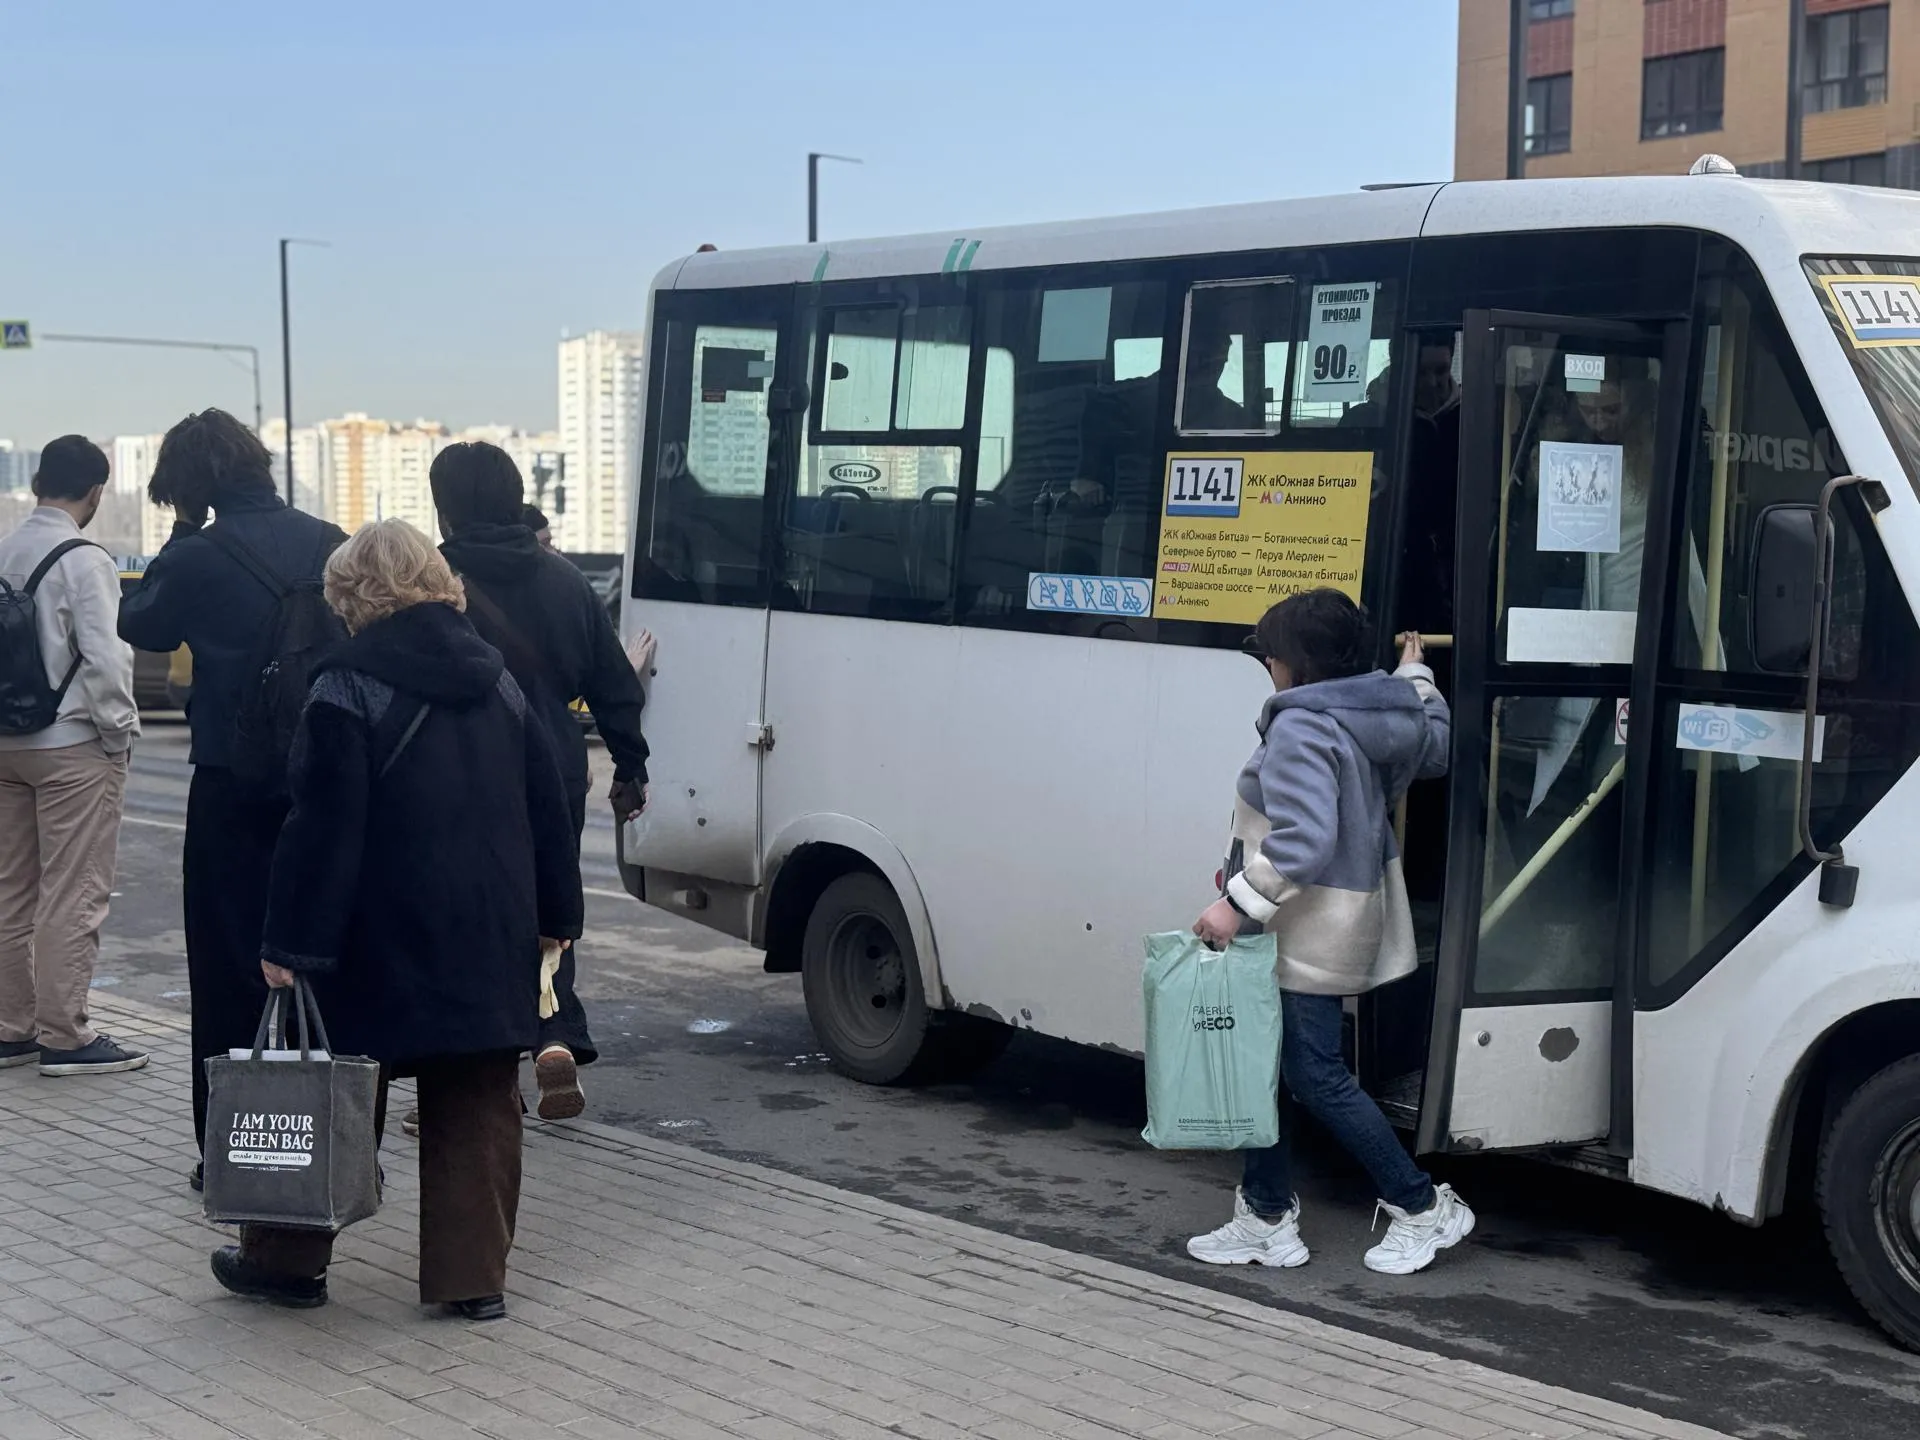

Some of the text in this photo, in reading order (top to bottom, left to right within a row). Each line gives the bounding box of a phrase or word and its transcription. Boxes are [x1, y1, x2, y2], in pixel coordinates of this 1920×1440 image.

[1317, 288, 1370, 304] СТОИМОСТЬ
[1321, 307, 1361, 322] ПРОЕЗДА
[1841, 290, 1920, 324] 1141
[1173, 466, 1236, 502] 1141
[1247, 474, 1357, 490] ЖК «Южная Битца»
[1284, 494, 1326, 506] Аннино
[1164, 529, 1179, 540] ЖК
[1264, 532, 1329, 545] Ботанический
[1331, 536, 1348, 547] сад
[1162, 545, 1204, 558] Северное
[1206, 546, 1237, 560] Бутово
[1285, 550, 1324, 563] Мерлен
[1190, 563, 1215, 575] МЦД
[1257, 565, 1313, 579] (Автовокзал
[1171, 578, 1224, 591] Варшавское
[1225, 583, 1254, 593] шоссе
[1177, 595, 1210, 607] Аннино
[232, 1112, 314, 1132] I AM YOUR
[229, 1131, 314, 1151] GREEN BAG
